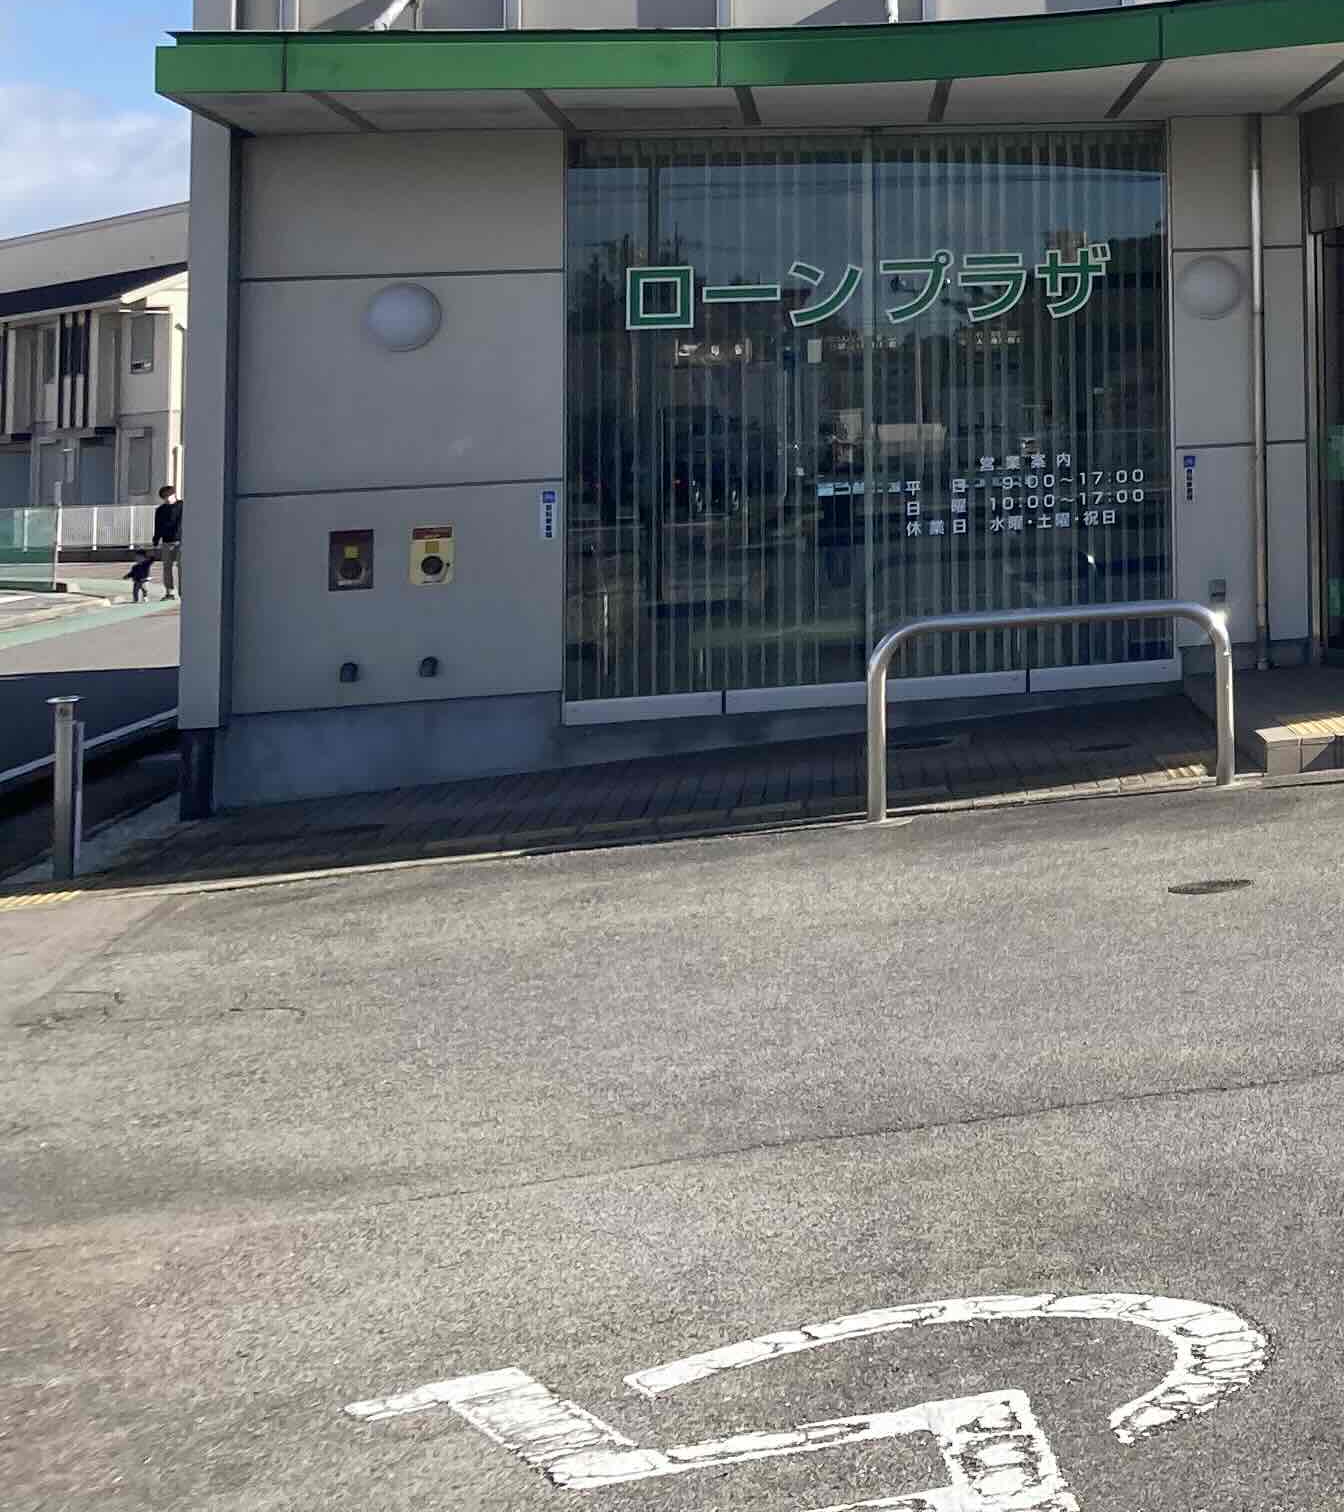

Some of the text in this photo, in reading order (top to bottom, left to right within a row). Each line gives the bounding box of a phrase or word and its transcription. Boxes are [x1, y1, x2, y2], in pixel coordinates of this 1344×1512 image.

[626, 244, 1111, 329] ローンプラザ
[905, 518, 967, 537] 休業日
